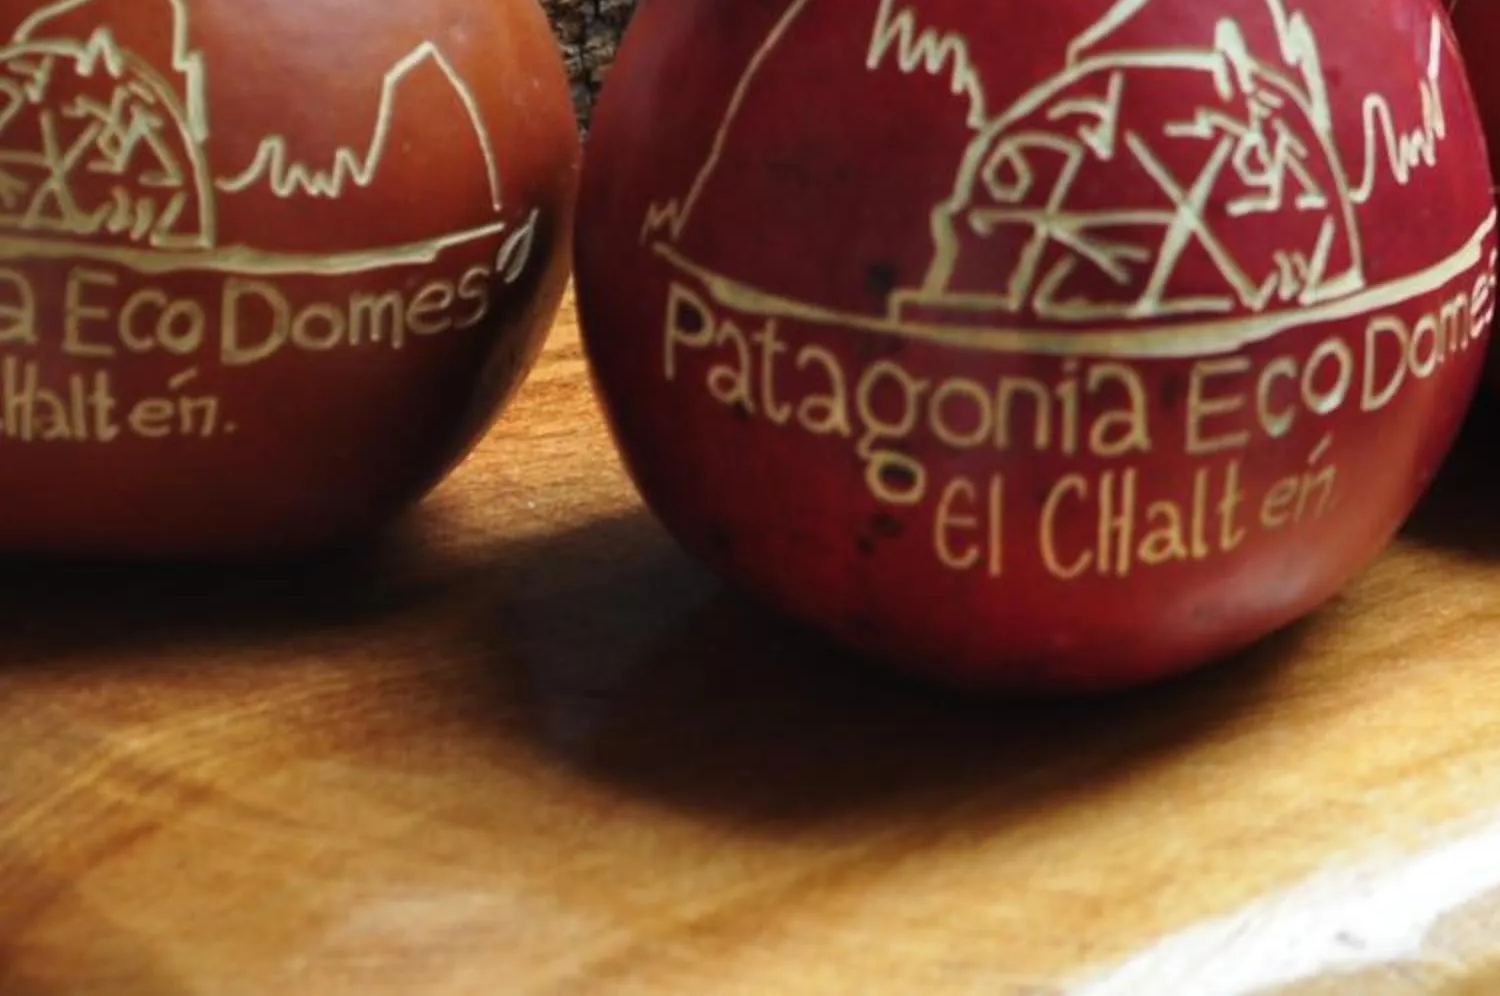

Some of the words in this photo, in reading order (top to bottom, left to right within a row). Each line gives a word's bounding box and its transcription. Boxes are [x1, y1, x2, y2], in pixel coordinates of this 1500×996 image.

[0, 355, 237, 443] Haltén.
[664, 282, 1152, 505] Patagonia
[1185, 337, 1354, 457] Eco
[934, 474, 1003, 578] El
